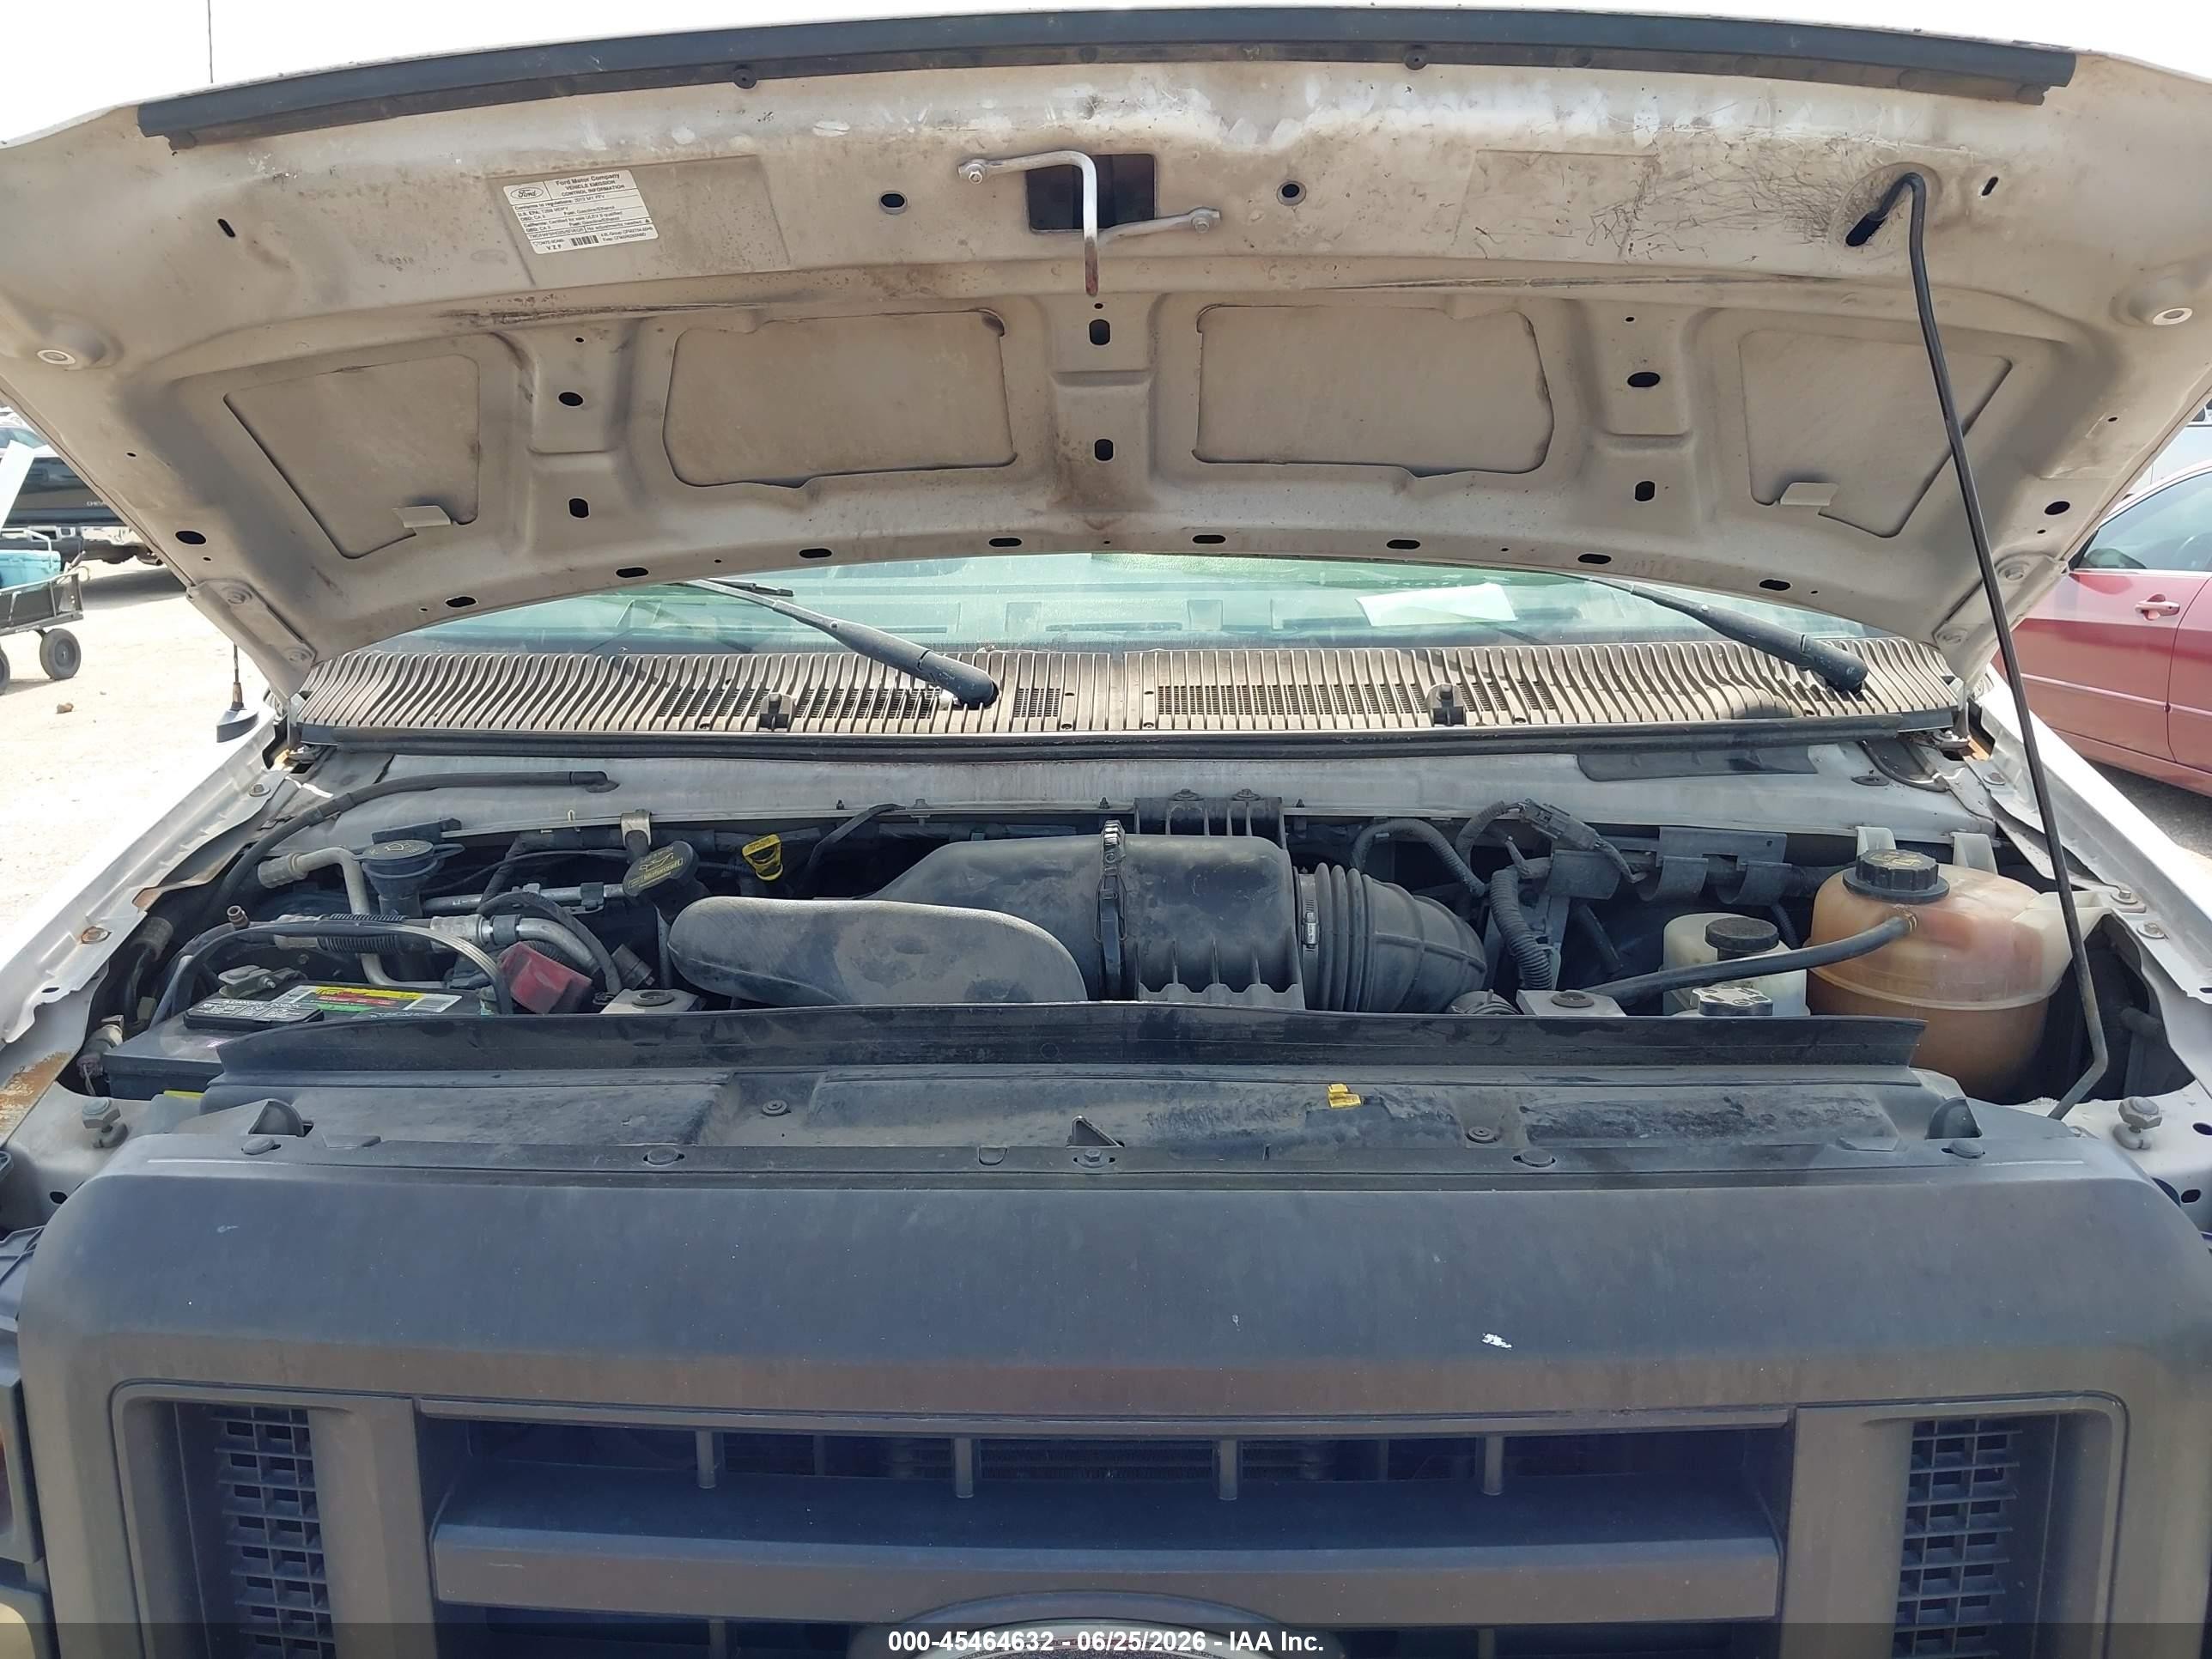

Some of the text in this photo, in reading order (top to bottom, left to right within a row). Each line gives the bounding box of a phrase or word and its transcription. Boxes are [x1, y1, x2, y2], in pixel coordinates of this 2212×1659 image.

[590, 173, 620, 181] Company
[587, 184, 625, 192] INFORMATION
[517, 188, 537, 198] Ford
